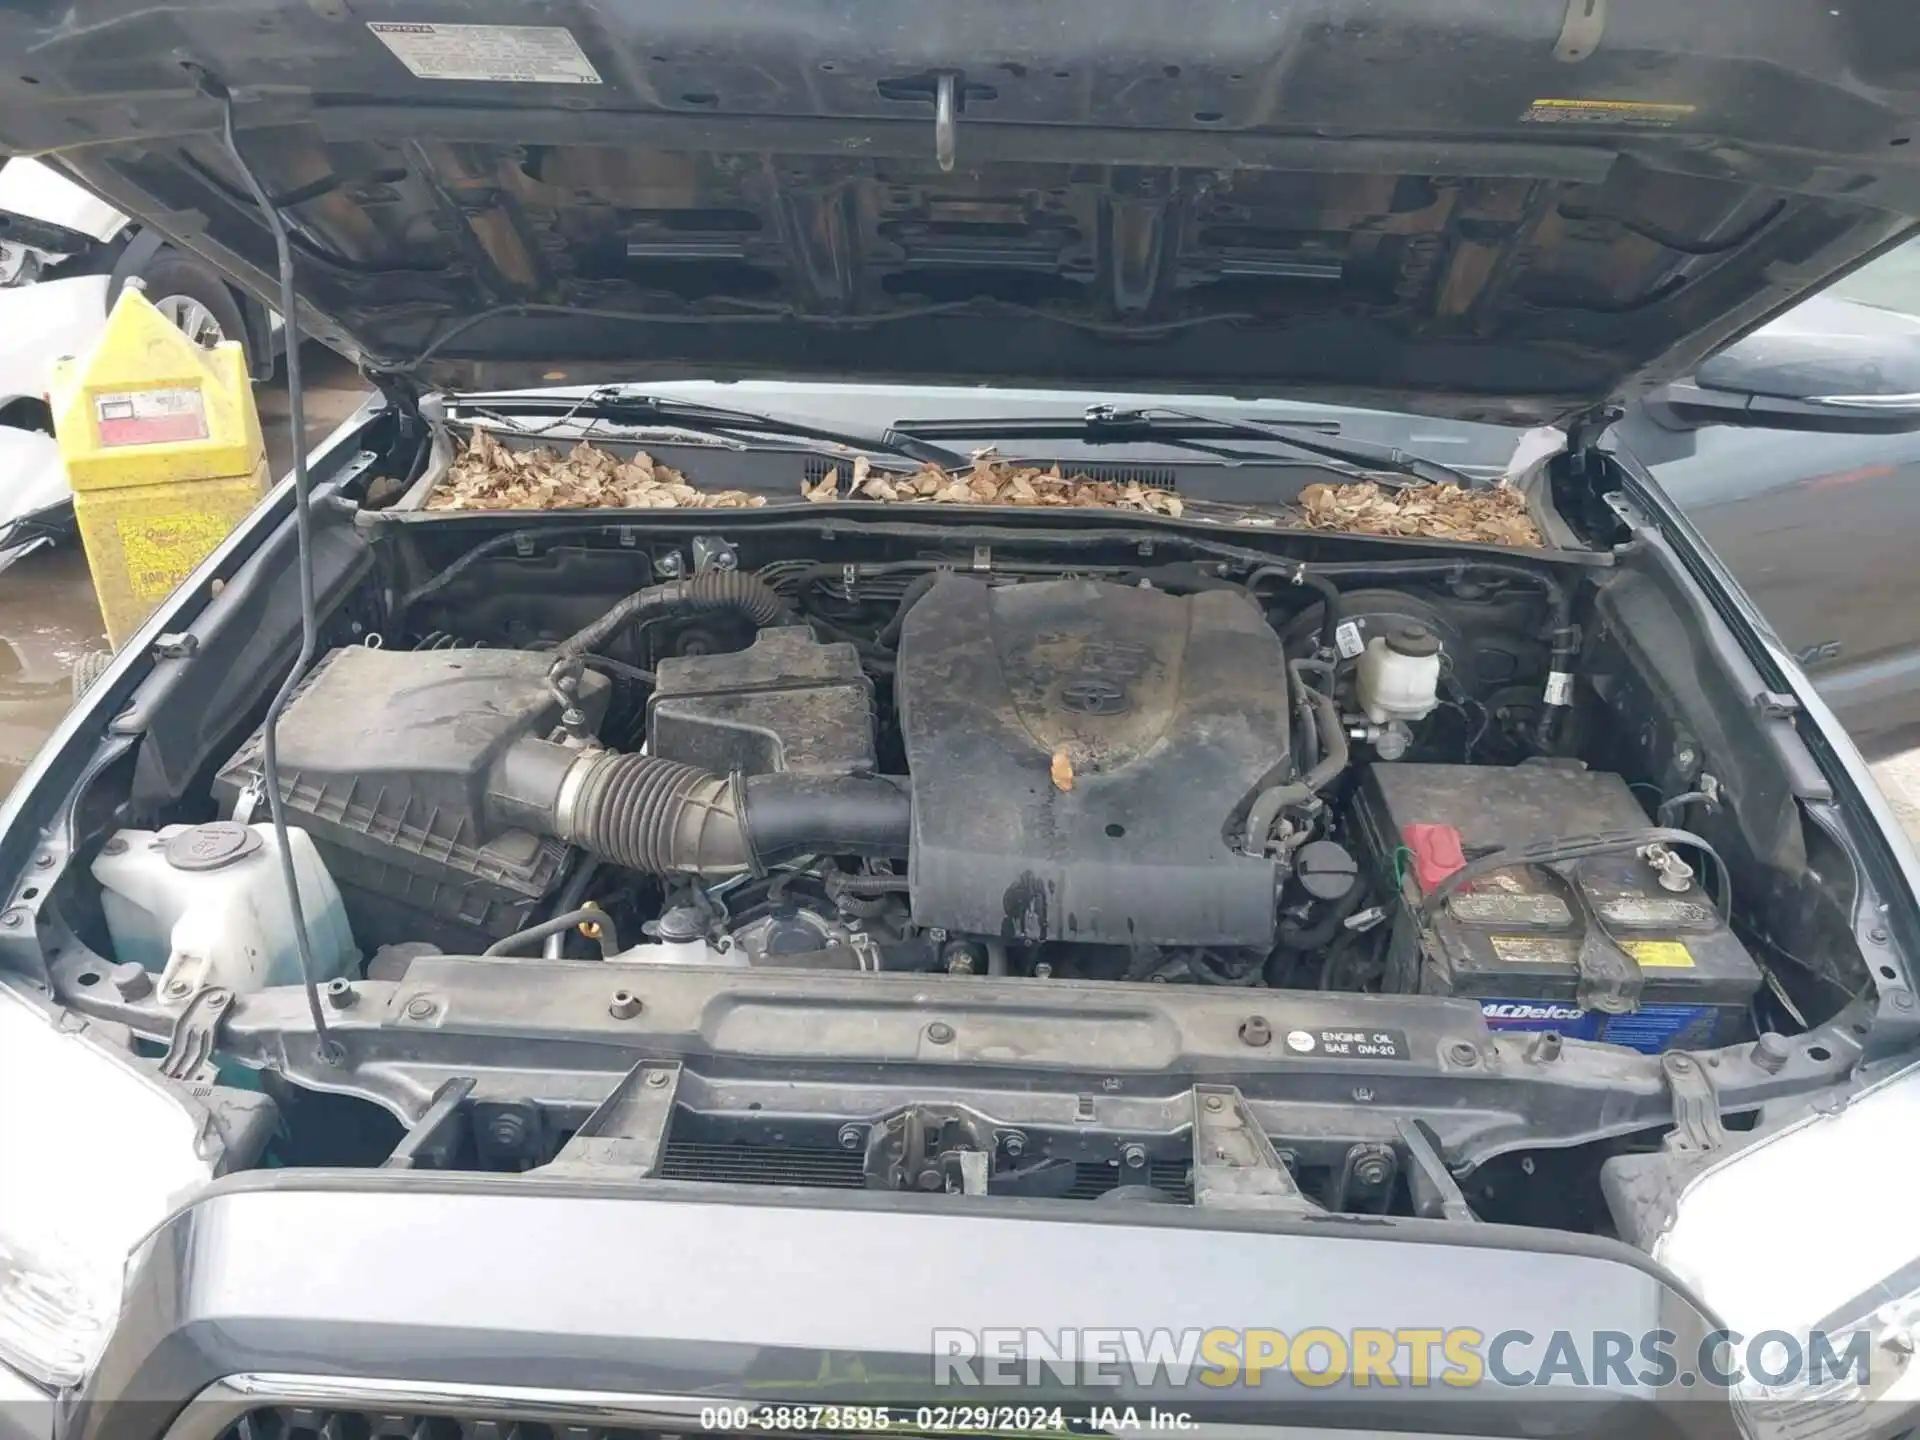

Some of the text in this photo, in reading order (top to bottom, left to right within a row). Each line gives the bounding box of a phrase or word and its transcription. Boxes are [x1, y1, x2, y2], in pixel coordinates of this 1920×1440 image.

[1482, 1004, 1584, 1019] ACDelco
[1321, 1032, 1366, 1042] ENGINE
[1372, 1033, 1394, 1045] OIL
[1324, 1043, 1395, 1055] SAE 0W-20
